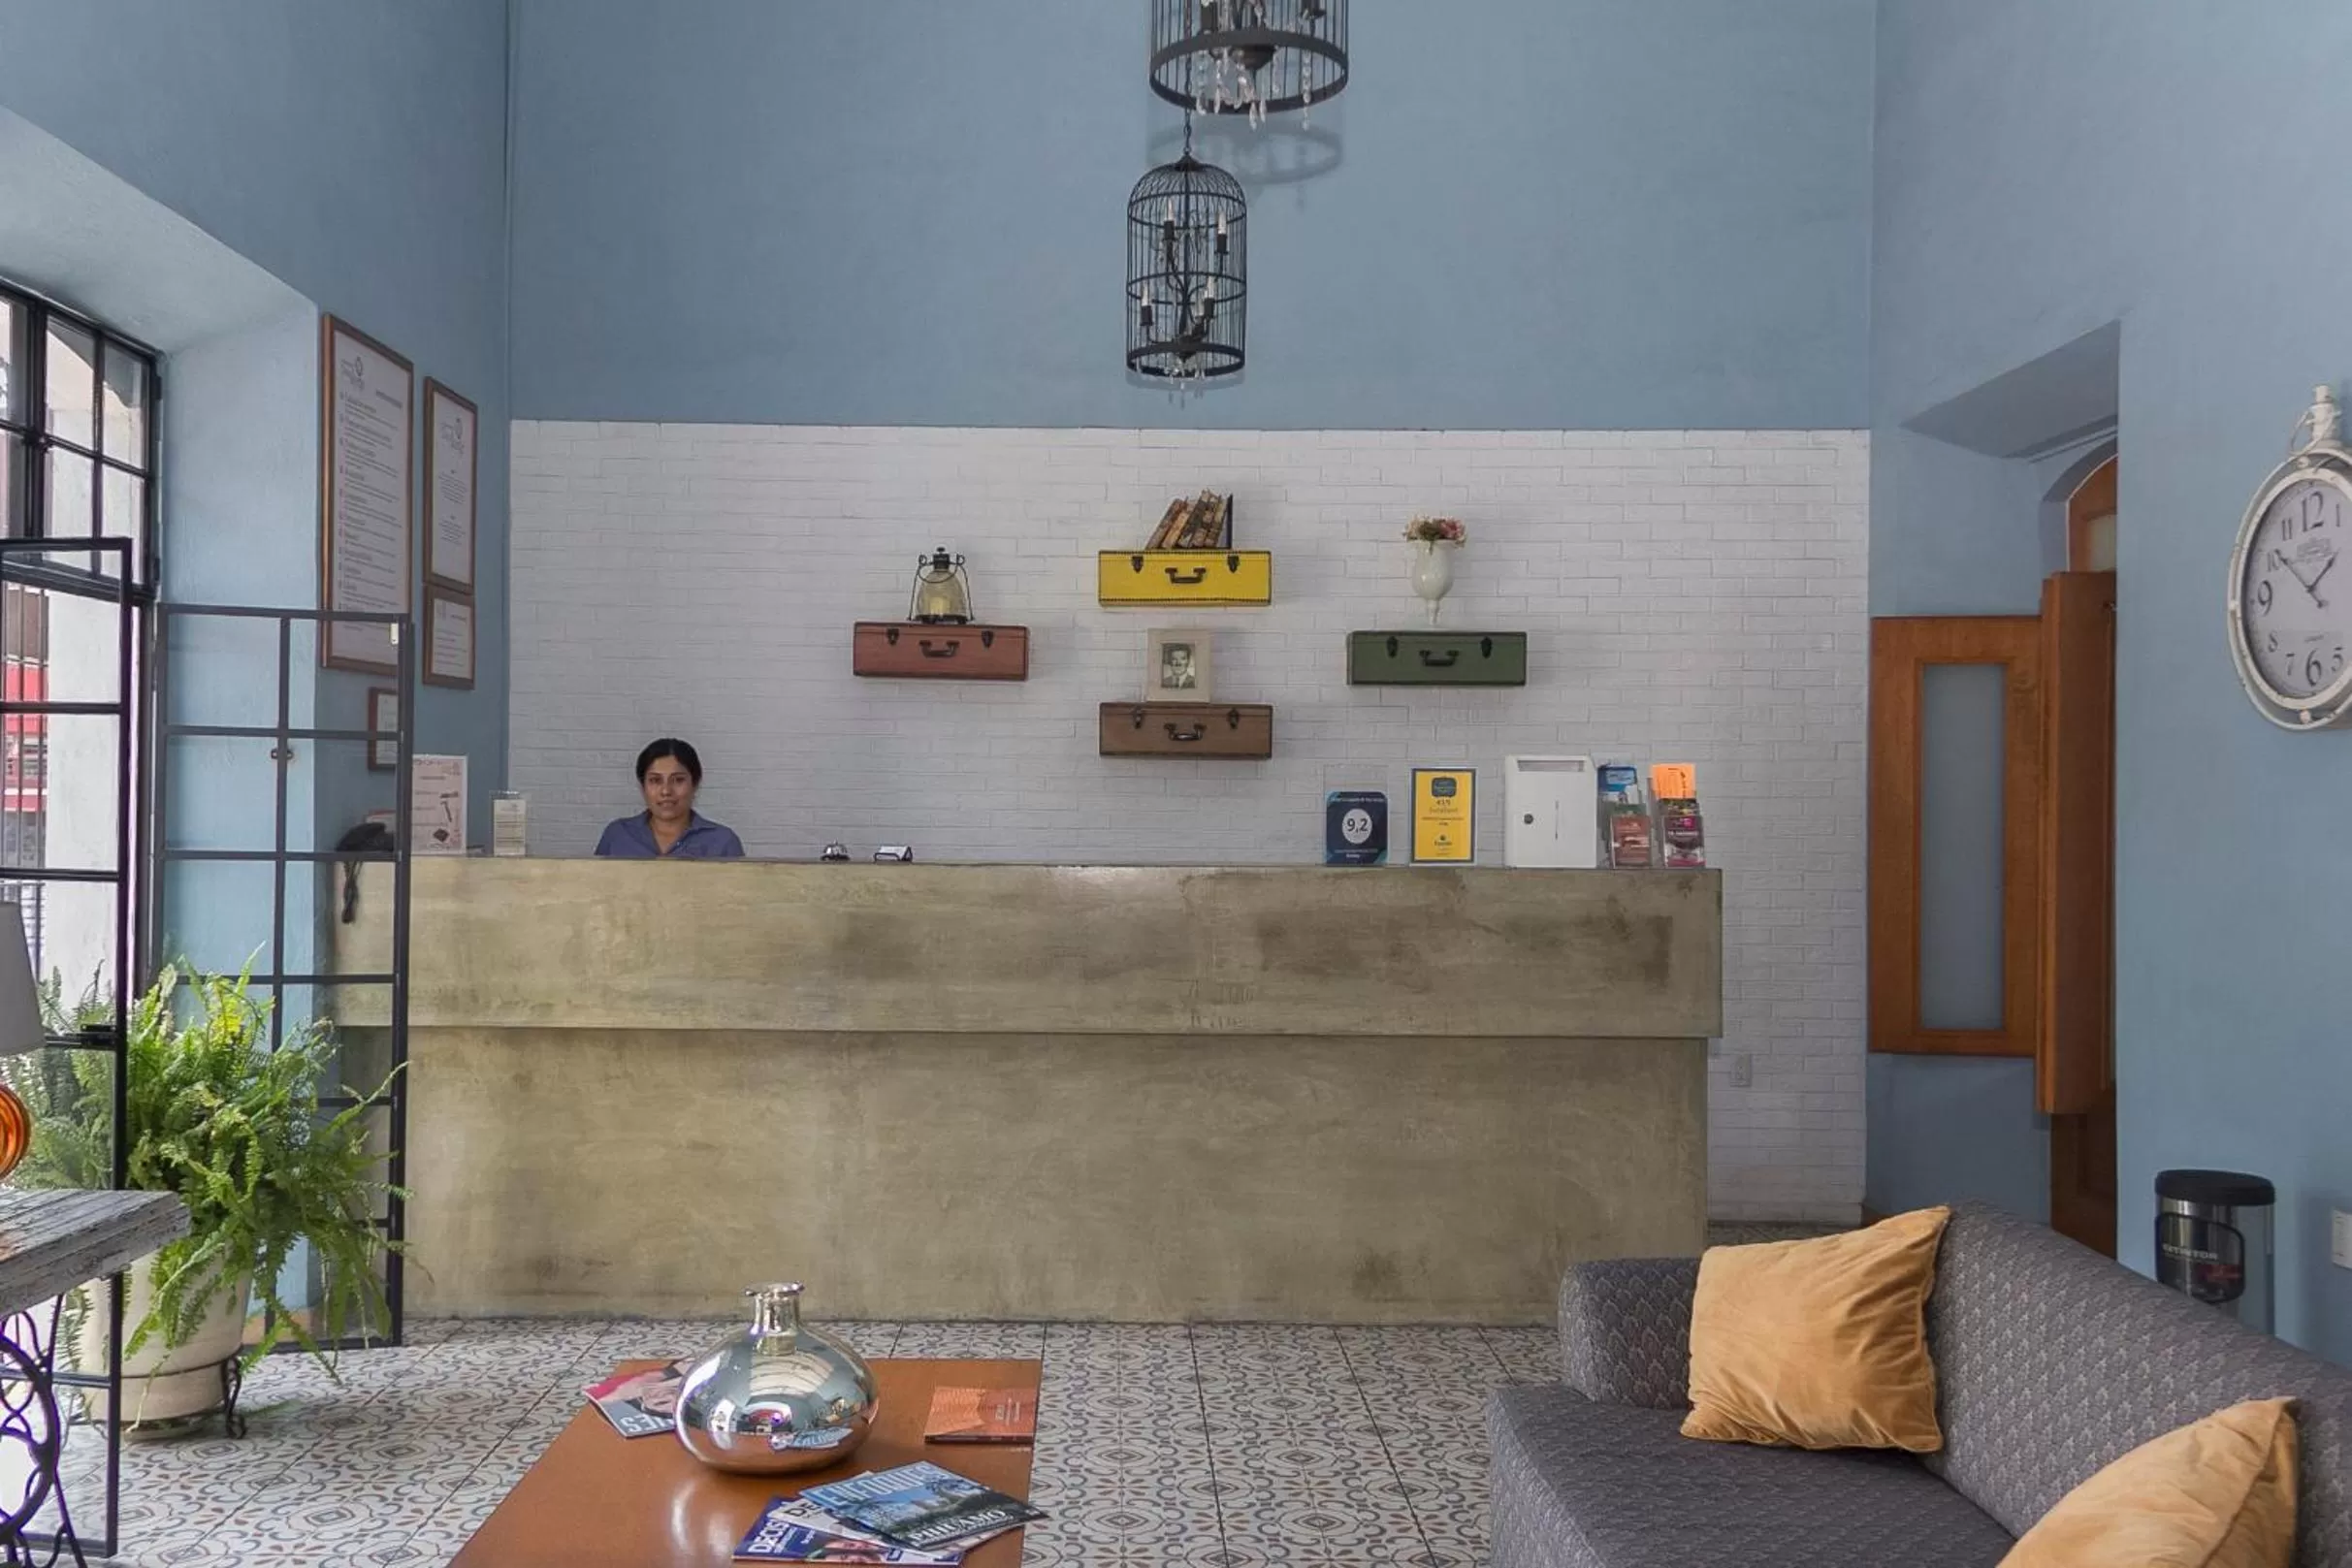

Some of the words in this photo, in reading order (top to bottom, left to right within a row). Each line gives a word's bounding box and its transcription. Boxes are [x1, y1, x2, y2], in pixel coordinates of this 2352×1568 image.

[2302, 491, 2324, 532] 12
[2336, 503, 2340, 528] 1
[2281, 517, 2294, 541] 11
[2257, 579, 2272, 617] 9
[2268, 628, 2278, 653] 8
[2285, 652, 2296, 676] 7
[2305, 647, 2322, 688] 6
[2331, 646, 2343, 672] 5
[811, 1464, 950, 1506] ENFOQUES
